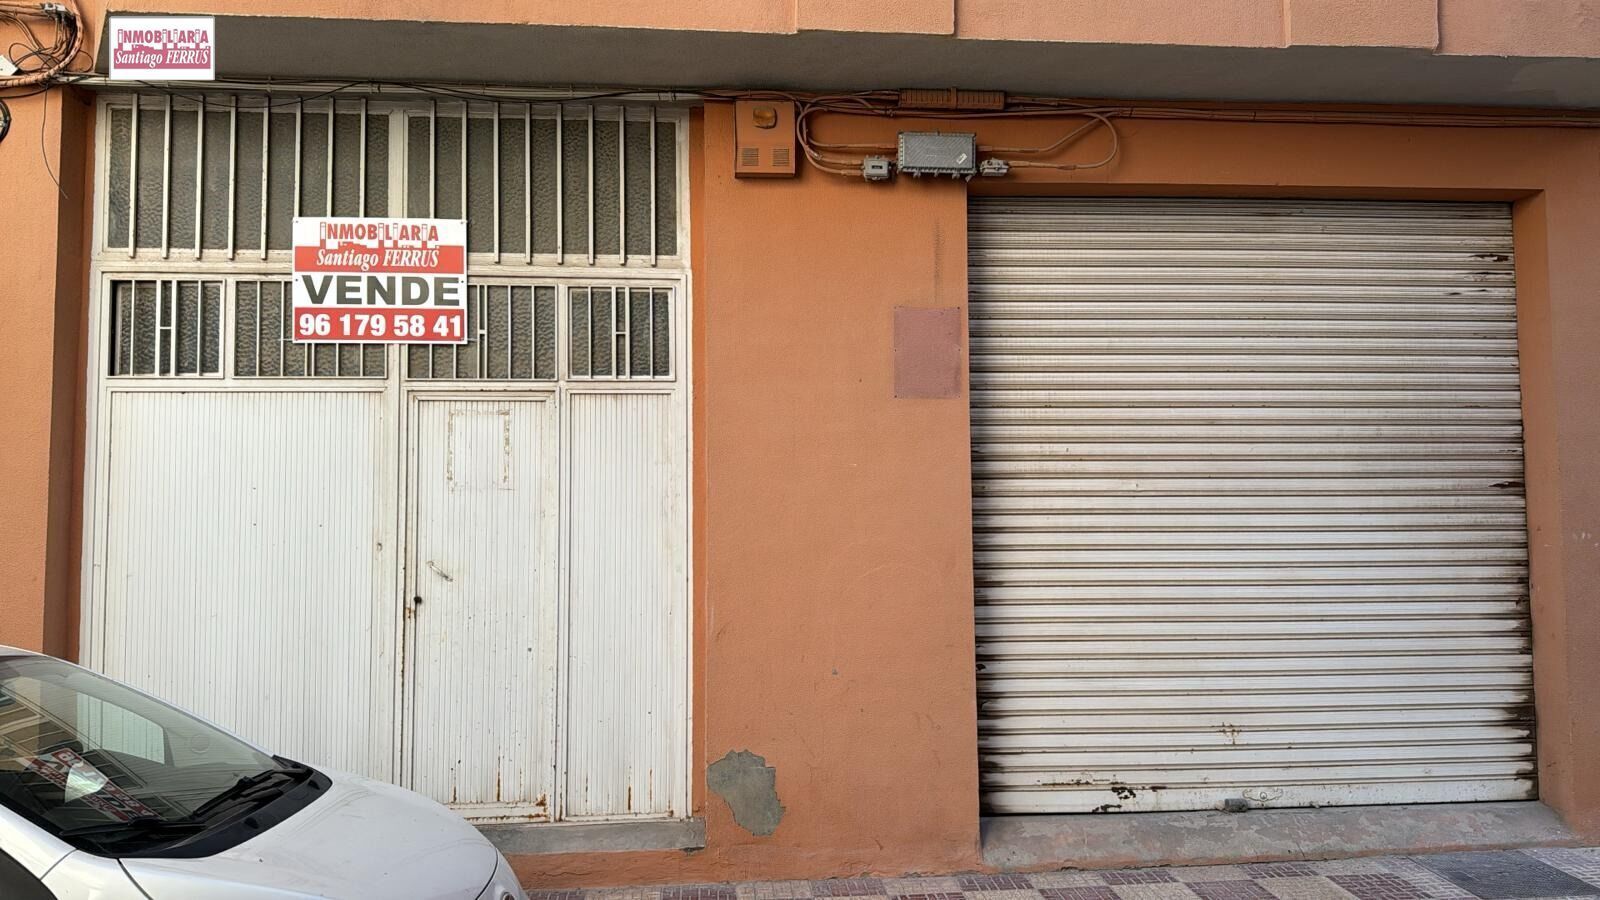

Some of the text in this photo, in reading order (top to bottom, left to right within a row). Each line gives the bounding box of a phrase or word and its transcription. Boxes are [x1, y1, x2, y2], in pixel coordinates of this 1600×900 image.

[316, 249, 440, 271] Santiago FERRUS
[302, 275, 460, 306] VENDE
[300, 314, 461, 337] 96 179 58 41
